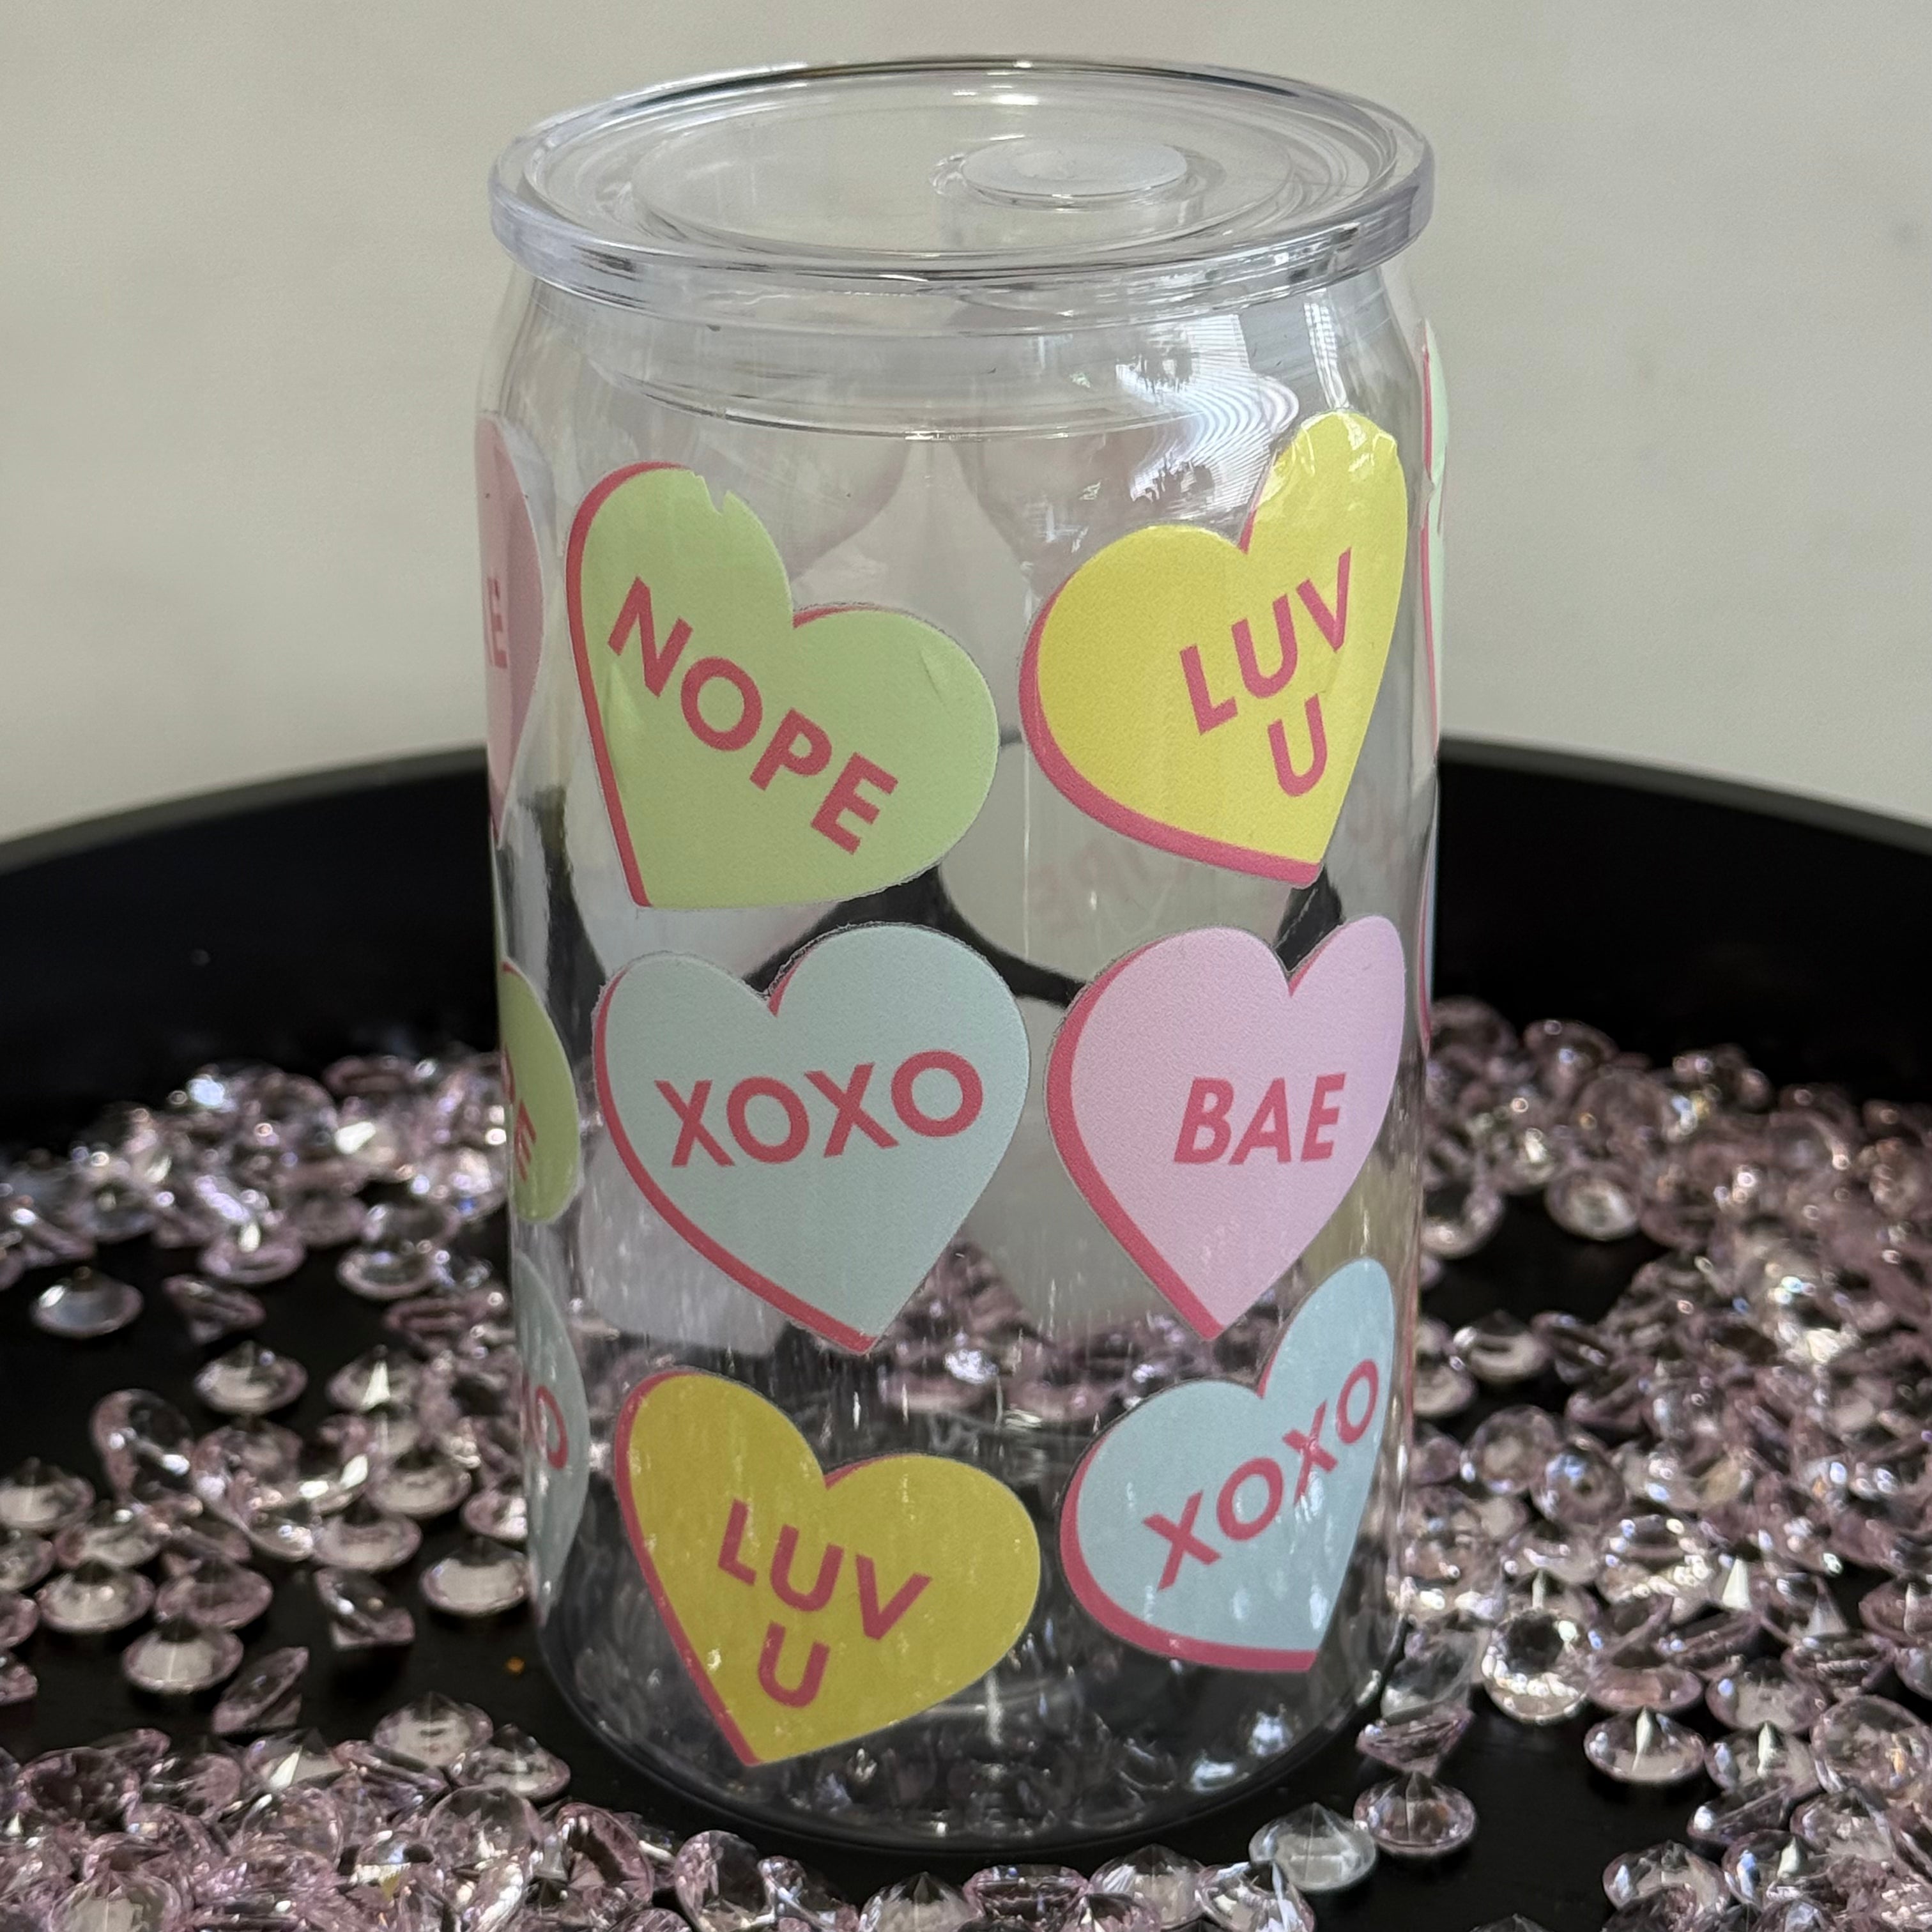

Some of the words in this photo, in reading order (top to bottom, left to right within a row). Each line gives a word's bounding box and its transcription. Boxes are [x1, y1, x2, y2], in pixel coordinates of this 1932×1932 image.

[1180, 548, 1351, 733] LUV
[608, 577, 897, 852] NOPE
[1268, 693, 1329, 796] U
[657, 1050, 983, 1166] XOXO
[1174, 1073, 1346, 1165] BAE
[1144, 1359, 1379, 1590] XOXO
[717, 1499, 930, 1641] LUV
[757, 1621, 829, 1708] U
